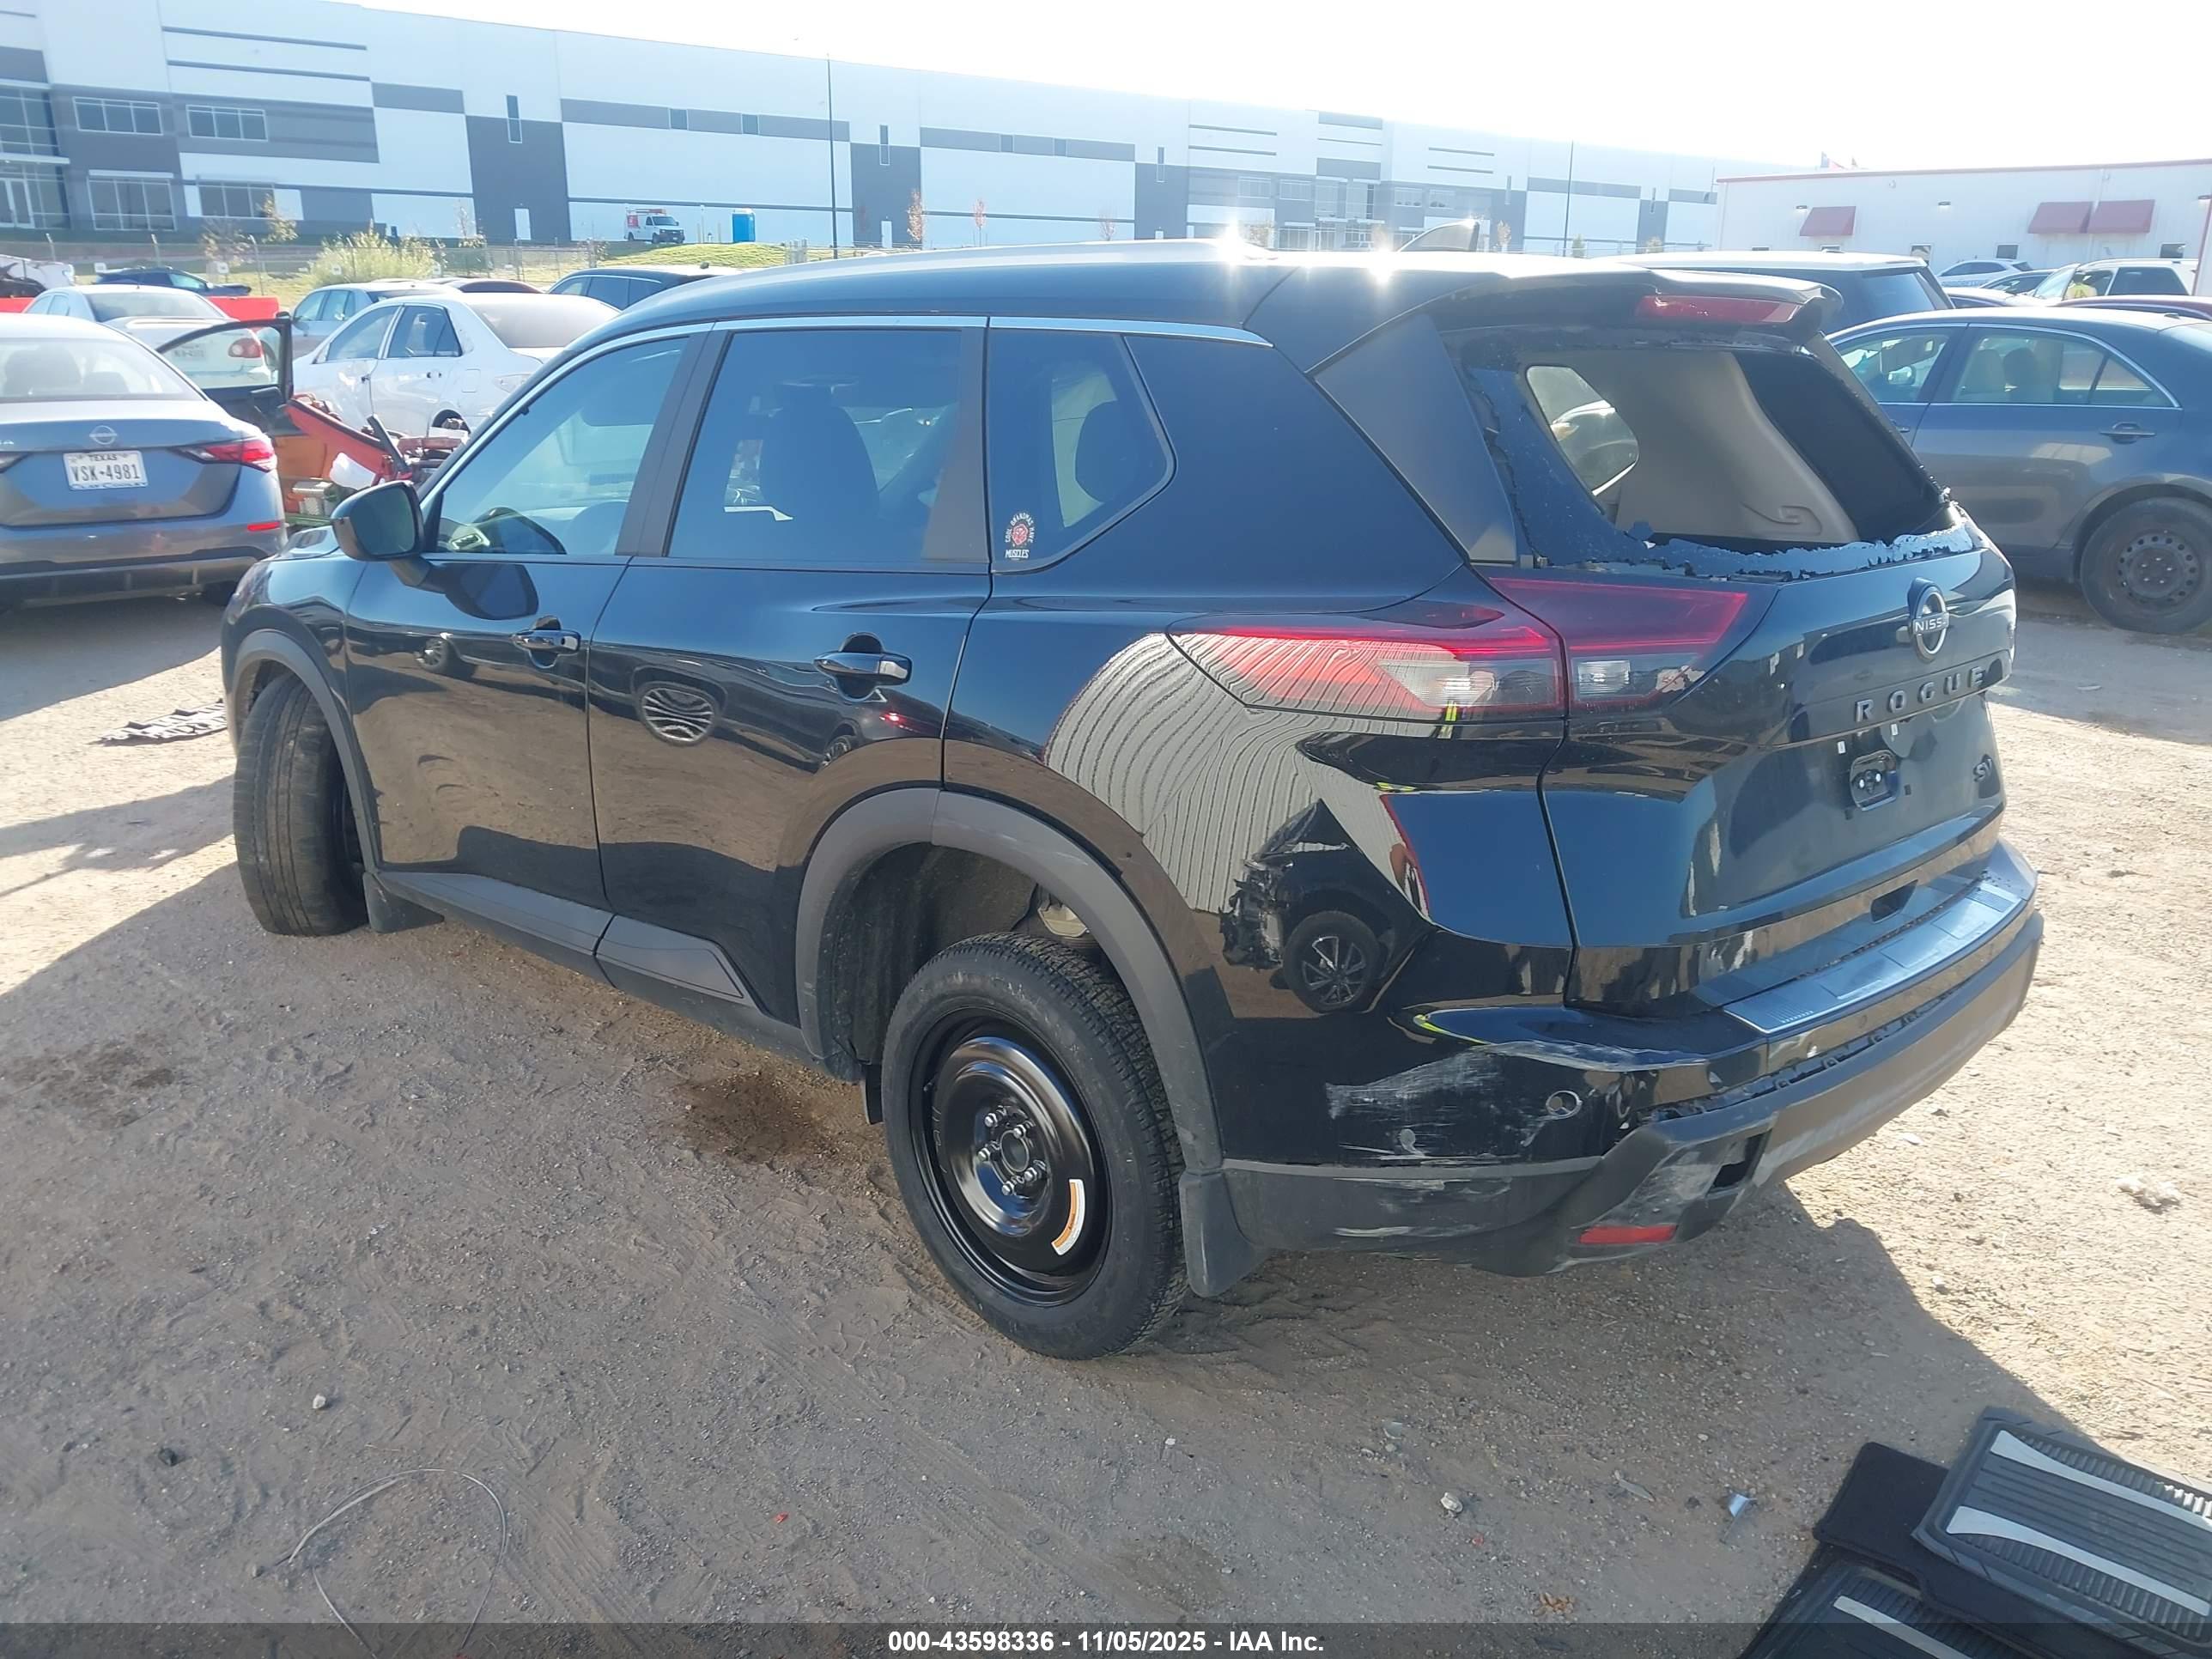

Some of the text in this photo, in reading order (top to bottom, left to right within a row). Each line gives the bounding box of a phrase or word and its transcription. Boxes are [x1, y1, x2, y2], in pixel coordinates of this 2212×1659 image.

[88, 453, 118, 462] TEXAS
[1005, 549, 1030, 559] MUSCLES
[1855, 666, 1985, 722] ROGUE
